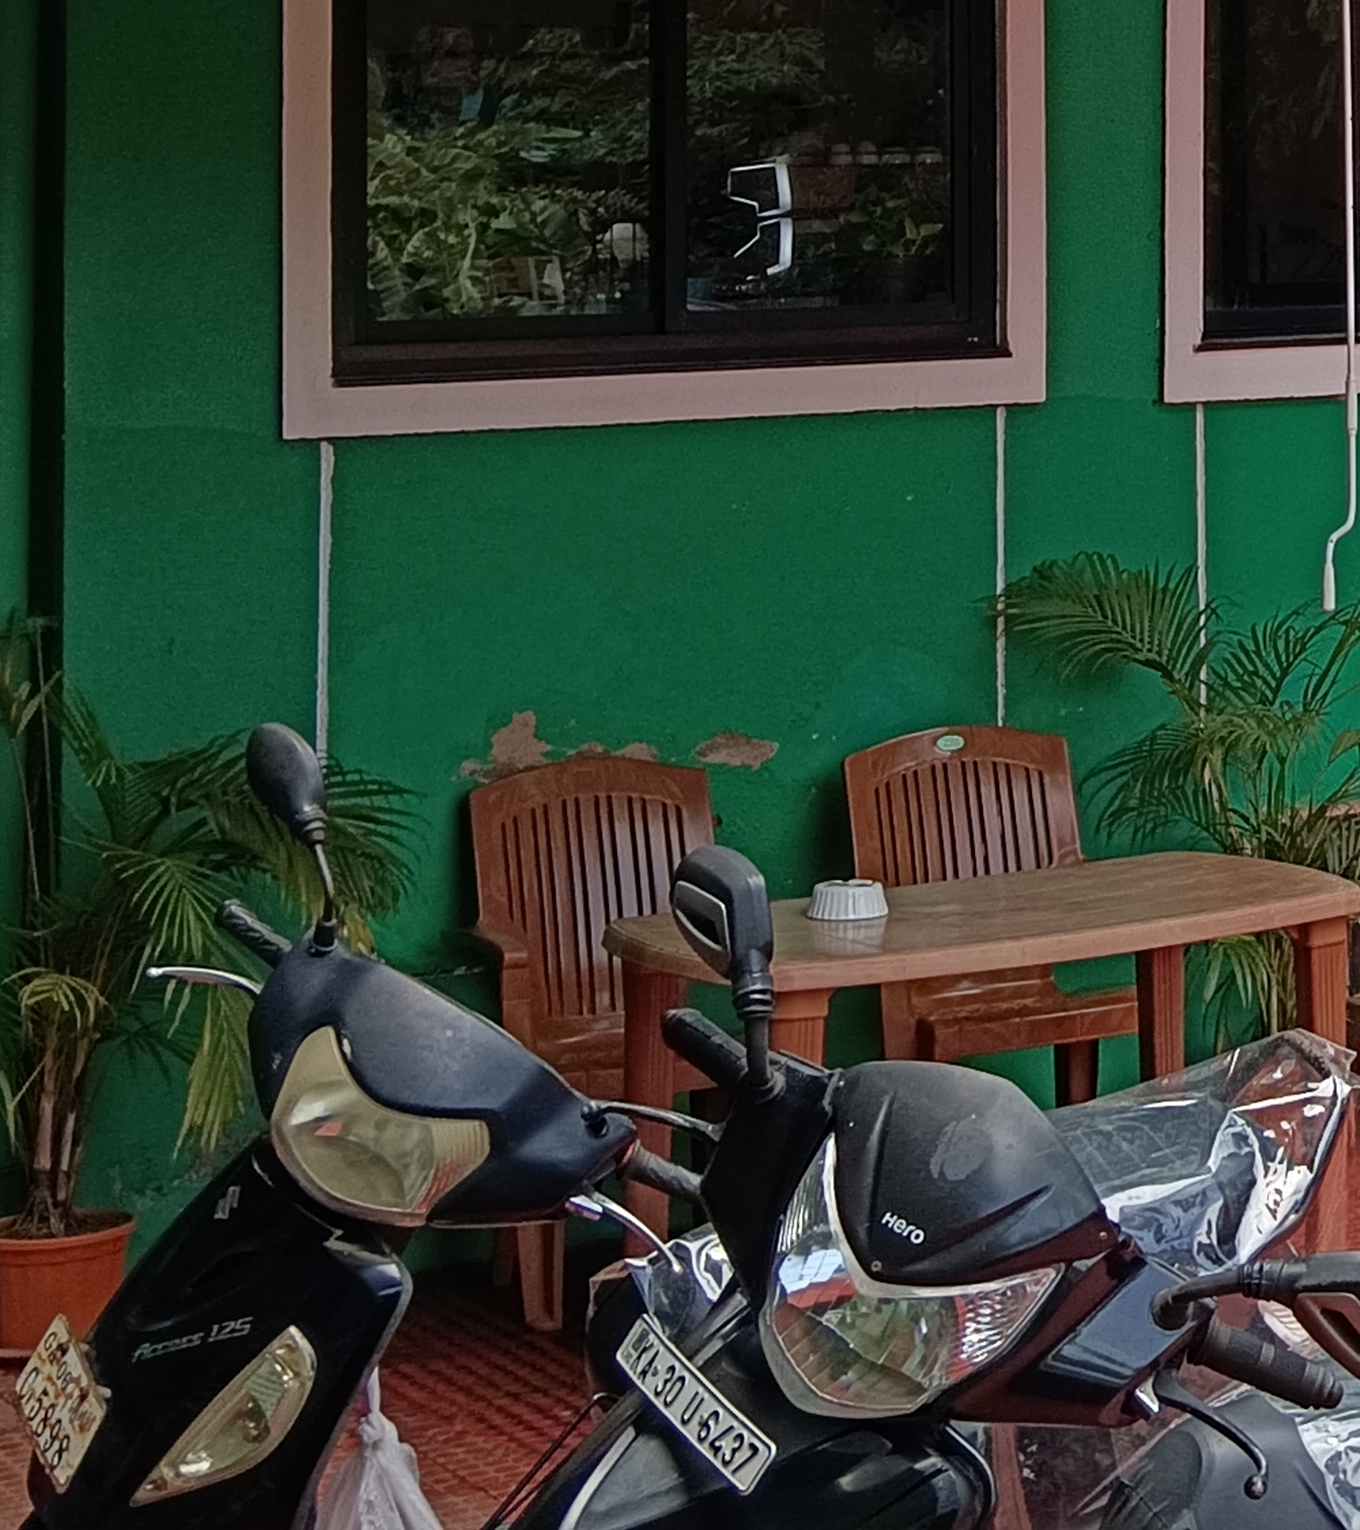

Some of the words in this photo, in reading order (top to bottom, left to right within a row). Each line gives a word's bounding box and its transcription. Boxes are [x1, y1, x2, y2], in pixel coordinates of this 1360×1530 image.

[881, 1212, 925, 1244] Hero
[208, 1316, 254, 1342] 125
[630, 1341, 660, 1385] KA
[654, 1364, 687, 1408] 30
[681, 1390, 705, 1425] U
[697, 1409, 760, 1475] 6437
